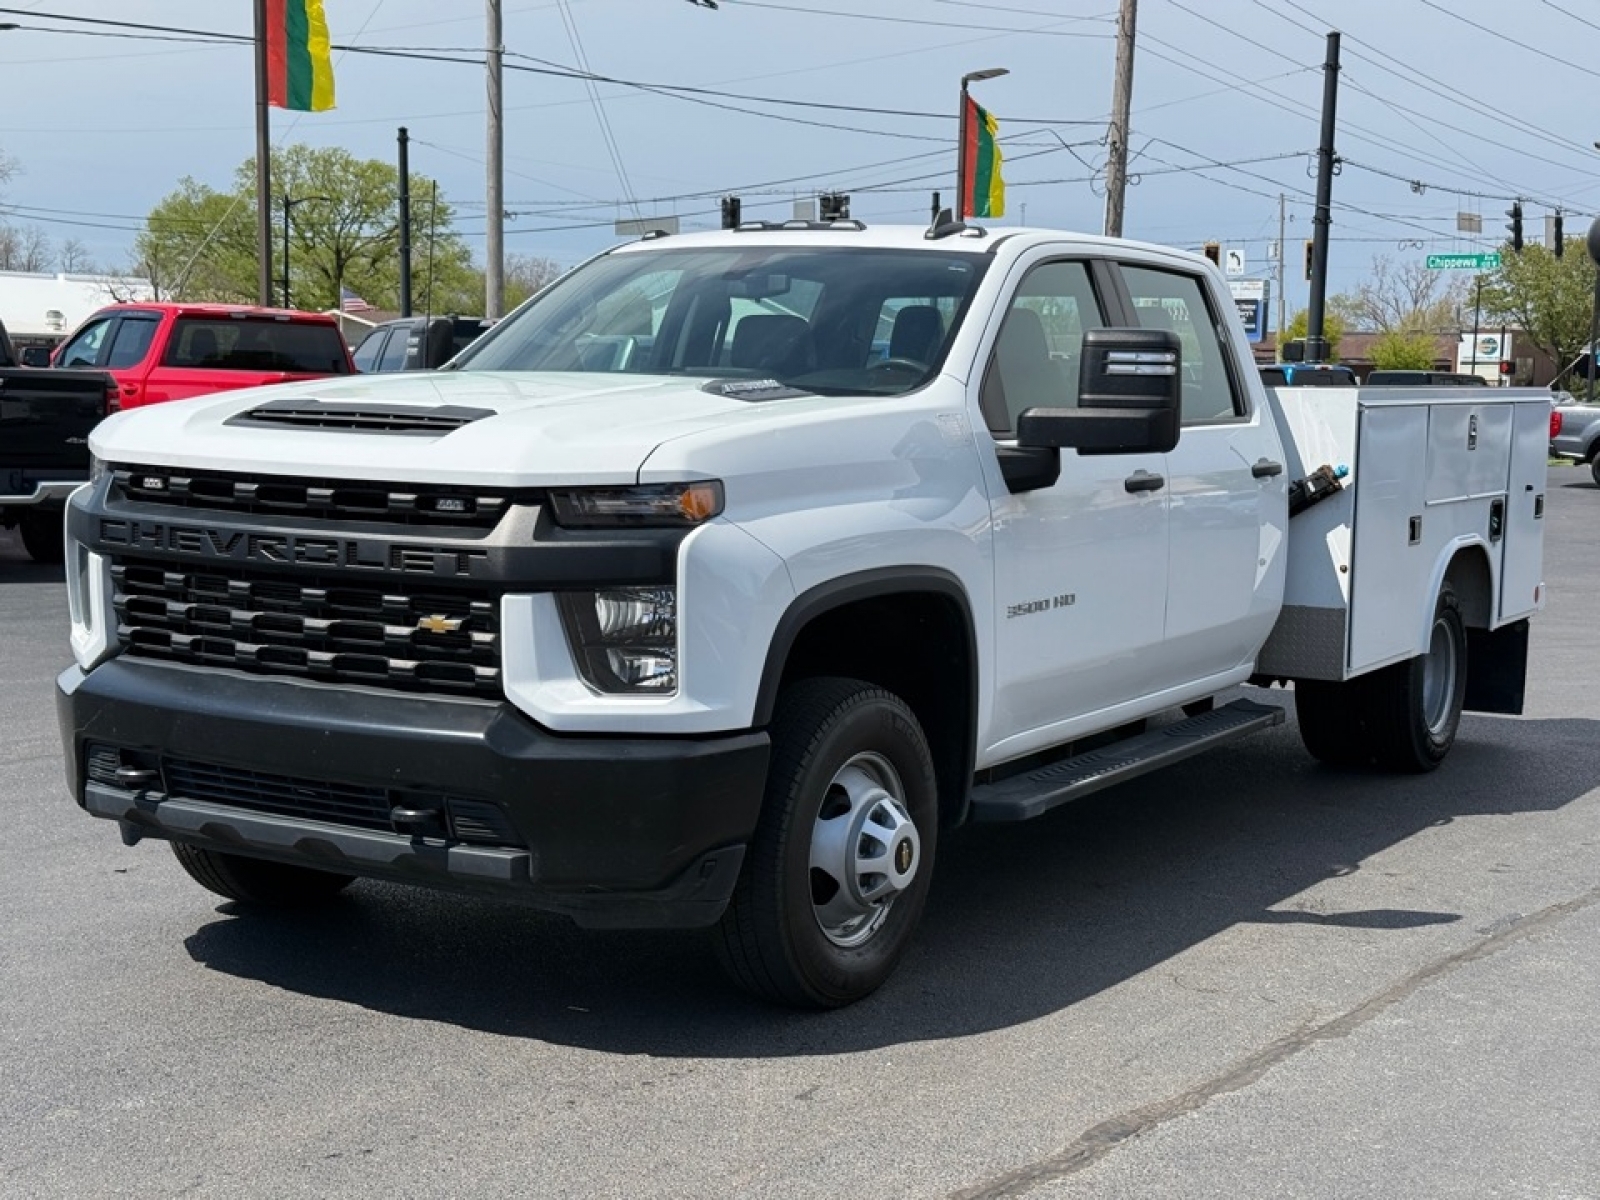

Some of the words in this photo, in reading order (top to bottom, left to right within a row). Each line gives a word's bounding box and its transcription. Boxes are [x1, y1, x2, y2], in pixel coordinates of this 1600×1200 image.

[101, 520, 488, 576] CHEVROLET
[1006, 599, 1050, 619] 3500
[1053, 593, 1076, 609] HD
